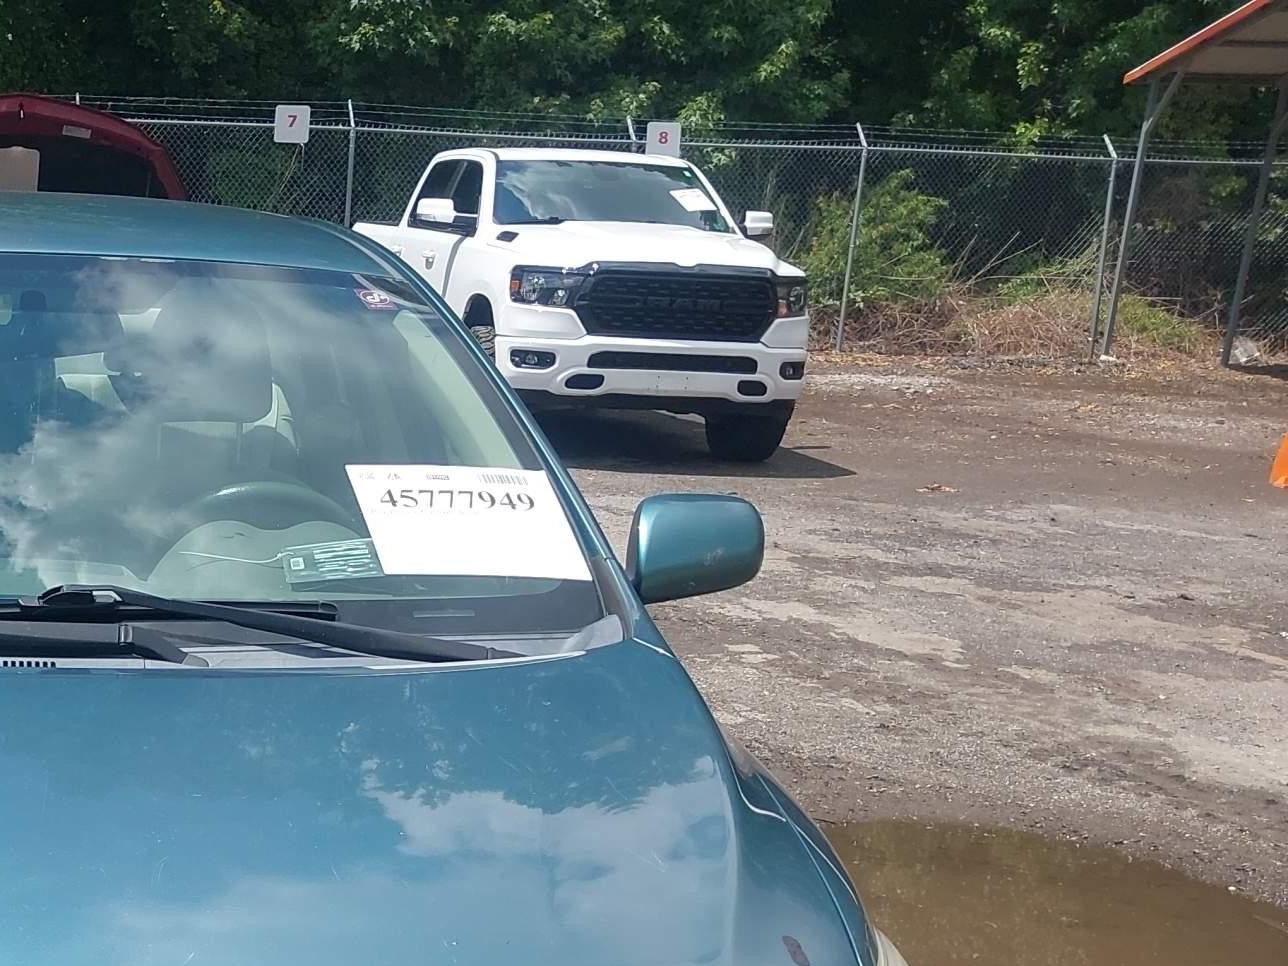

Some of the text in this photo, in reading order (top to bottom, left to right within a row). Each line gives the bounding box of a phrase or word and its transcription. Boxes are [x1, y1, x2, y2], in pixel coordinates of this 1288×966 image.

[287, 114, 298, 128] 7
[658, 131, 669, 145] 8
[380, 488, 535, 512] 45777949
